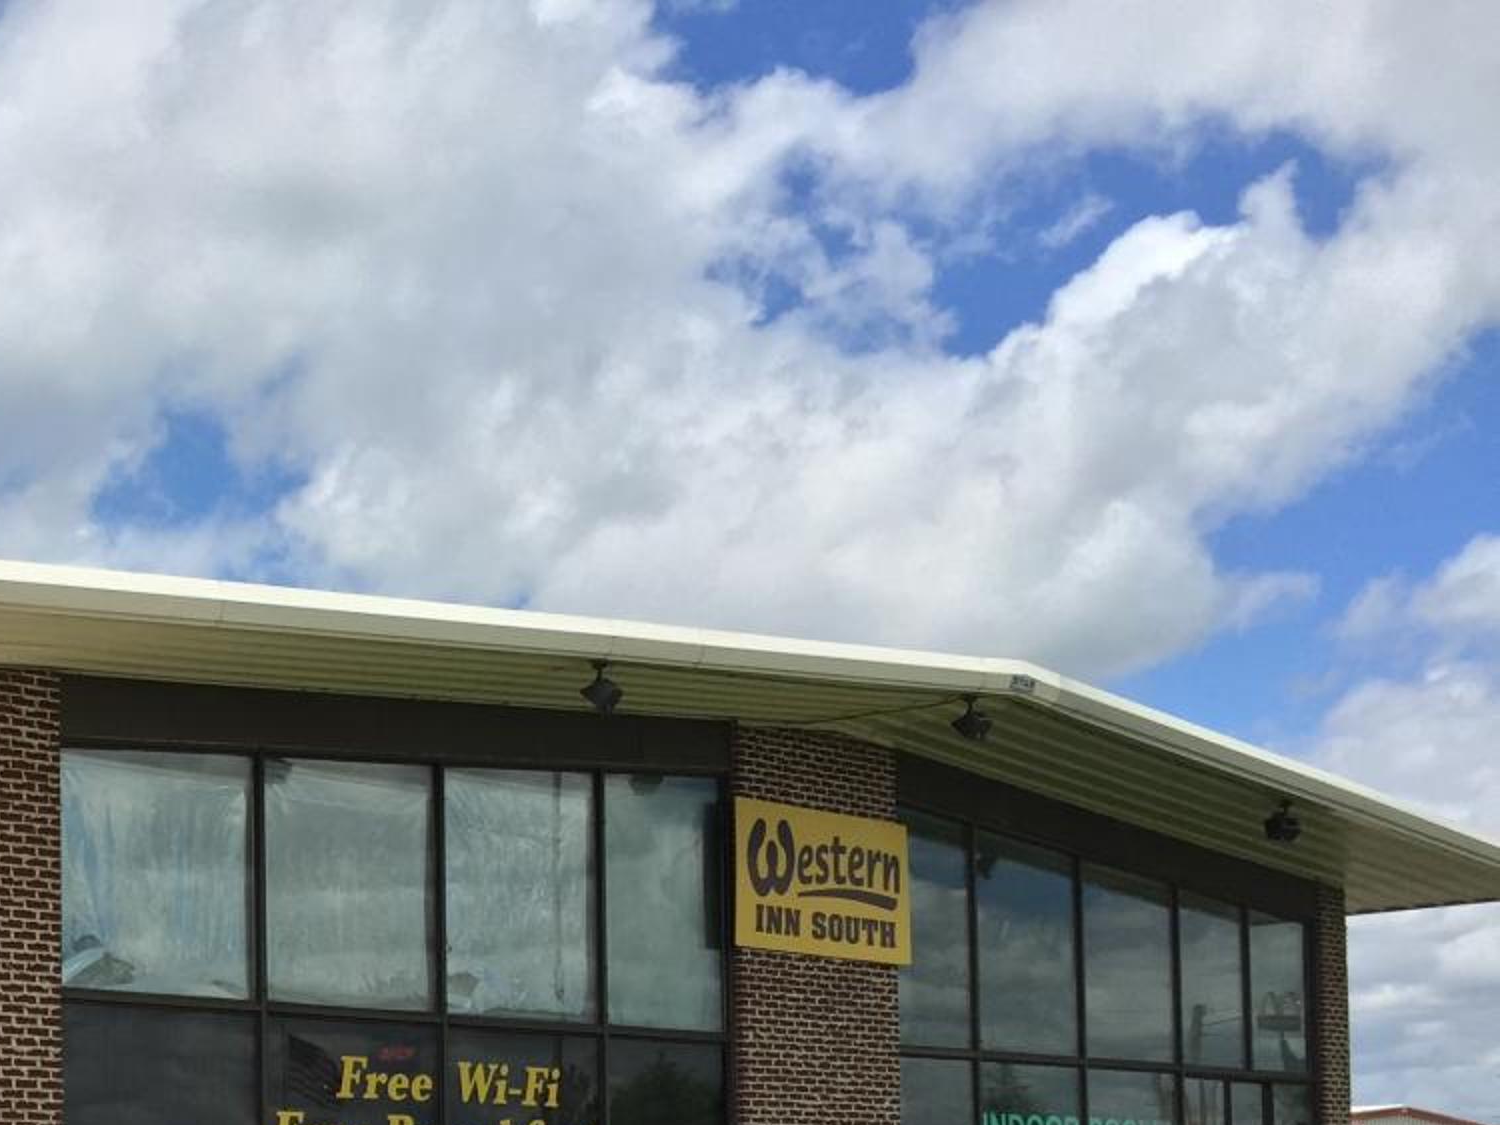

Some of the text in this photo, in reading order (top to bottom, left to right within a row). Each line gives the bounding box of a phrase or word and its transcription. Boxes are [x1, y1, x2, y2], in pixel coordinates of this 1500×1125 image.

[747, 818, 900, 897] Western
[755, 904, 897, 949] INN SOUTH
[335, 1055, 561, 1108] Free Wi-Fi
